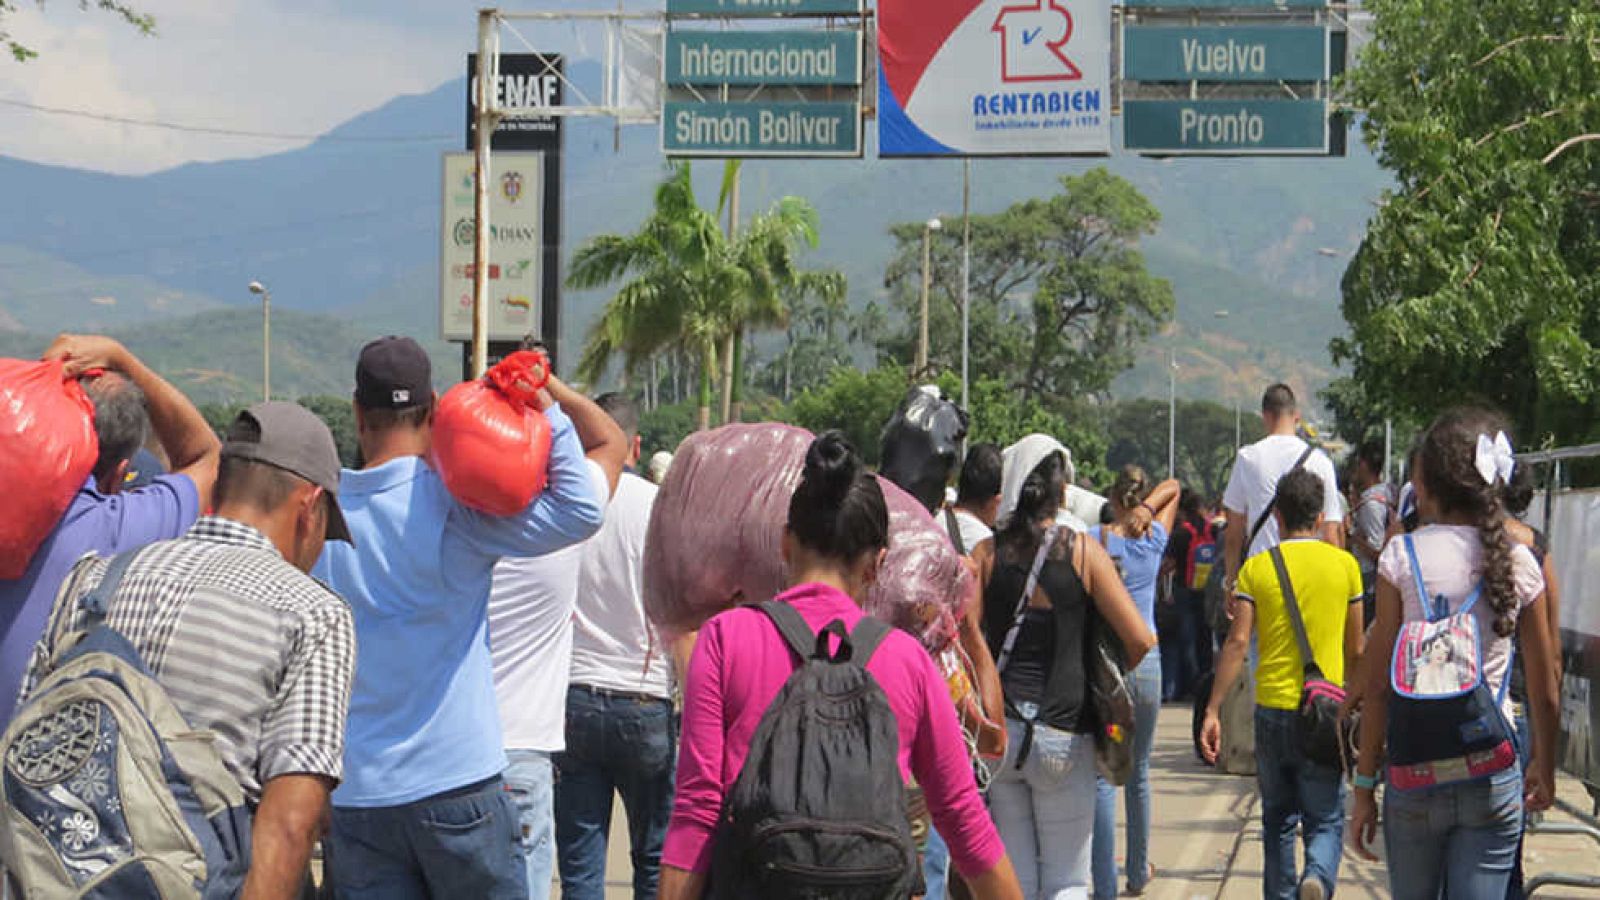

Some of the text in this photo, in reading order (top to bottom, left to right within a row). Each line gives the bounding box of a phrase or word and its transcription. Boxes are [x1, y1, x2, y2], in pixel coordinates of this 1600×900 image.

[680, 42, 837, 77] Internacional
[1182, 38, 1265, 73] Vuelva
[973, 89, 1100, 116] RENTABIEN
[676, 109, 750, 144] Simón
[1181, 108, 1264, 143] Pronto
